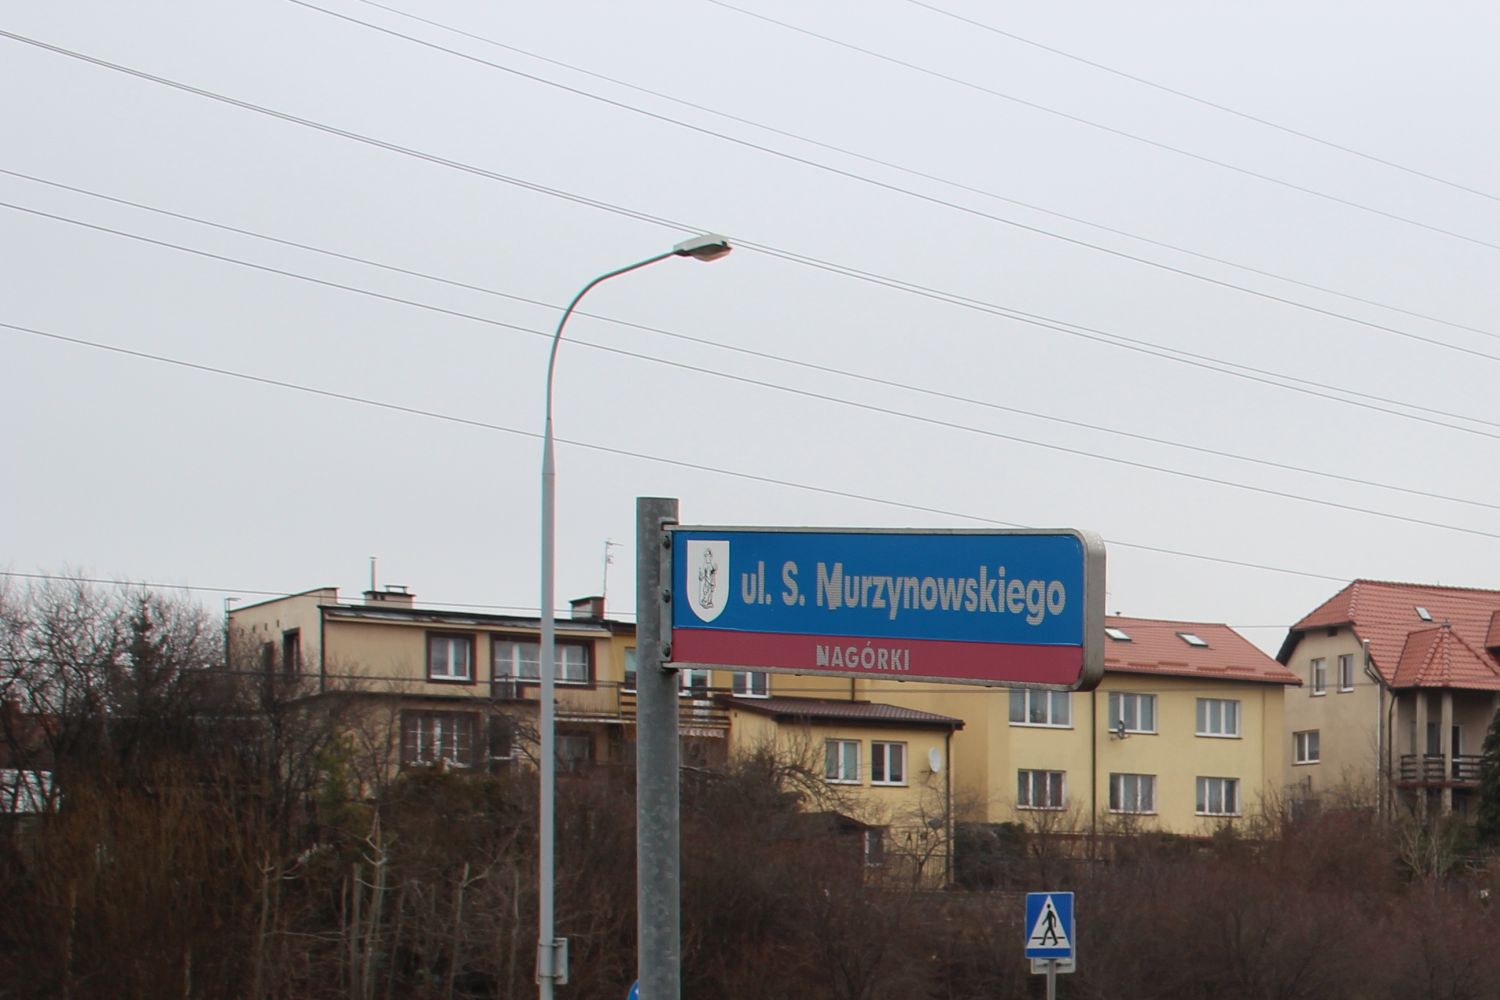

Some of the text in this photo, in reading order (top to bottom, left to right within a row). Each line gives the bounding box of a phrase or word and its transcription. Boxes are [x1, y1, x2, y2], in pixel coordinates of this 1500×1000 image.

[742, 560, 1066, 625] ul. S. Murzynowskiego
[816, 641, 911, 671] NAGÓRKI
